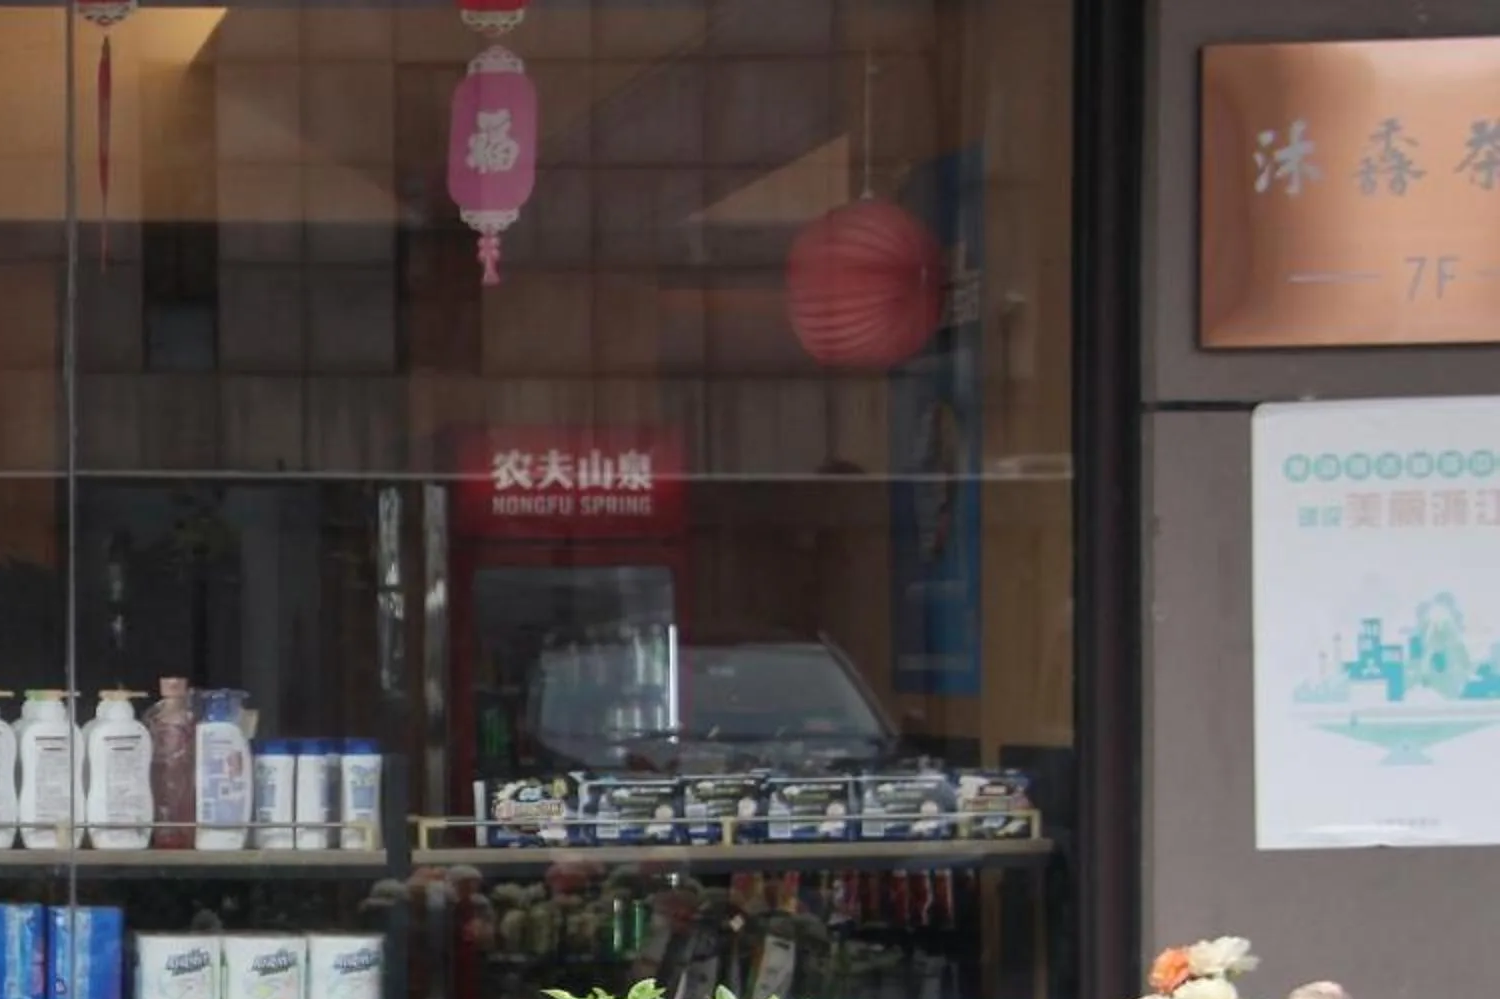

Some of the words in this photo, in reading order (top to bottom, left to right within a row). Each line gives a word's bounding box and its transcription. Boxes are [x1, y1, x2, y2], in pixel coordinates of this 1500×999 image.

[1405, 255, 1461, 301] 7F
[492, 448, 653, 491] 农夫山泉
[580, 495, 653, 516] SPRING
